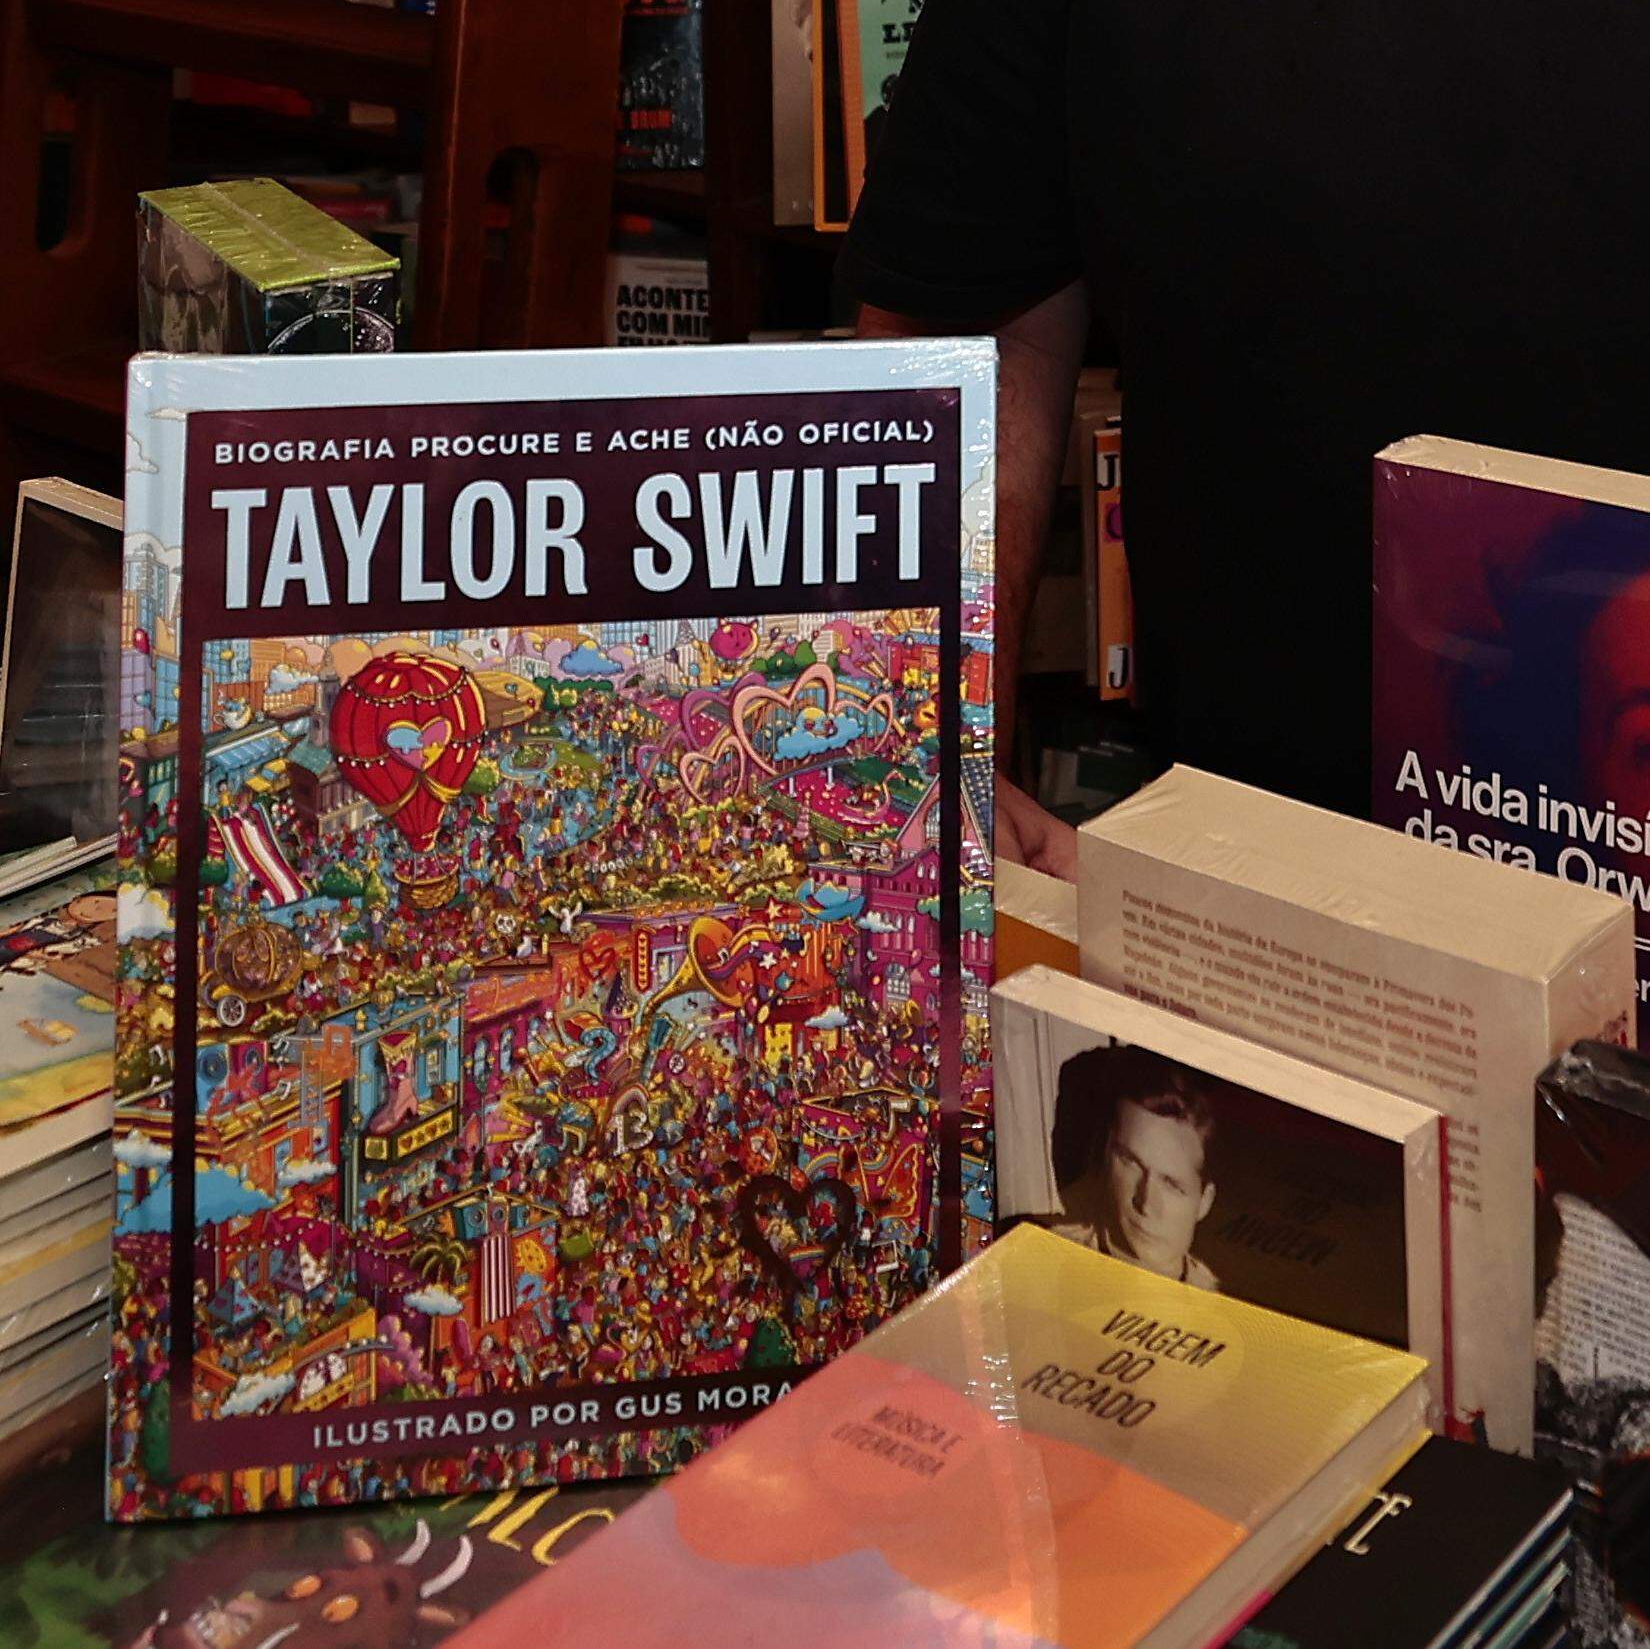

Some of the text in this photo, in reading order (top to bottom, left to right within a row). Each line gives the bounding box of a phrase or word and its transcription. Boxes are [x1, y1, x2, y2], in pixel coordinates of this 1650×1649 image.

[214, 418, 937, 465] BIOGRAFIA PROCURE E ACHE (NÃO OFICIAL)
[211, 462, 937, 611] TAYLOR SWIFT
[1395, 750, 1431, 799] A
[1436, 765, 1528, 826] vida
[1095, 1349, 1156, 1384] DO
[1101, 1309, 1227, 1368] VIAGEM
[312, 1391, 684, 1450] ILUSTRADO POR GUS
[1020, 1364, 1157, 1429] RECADO
